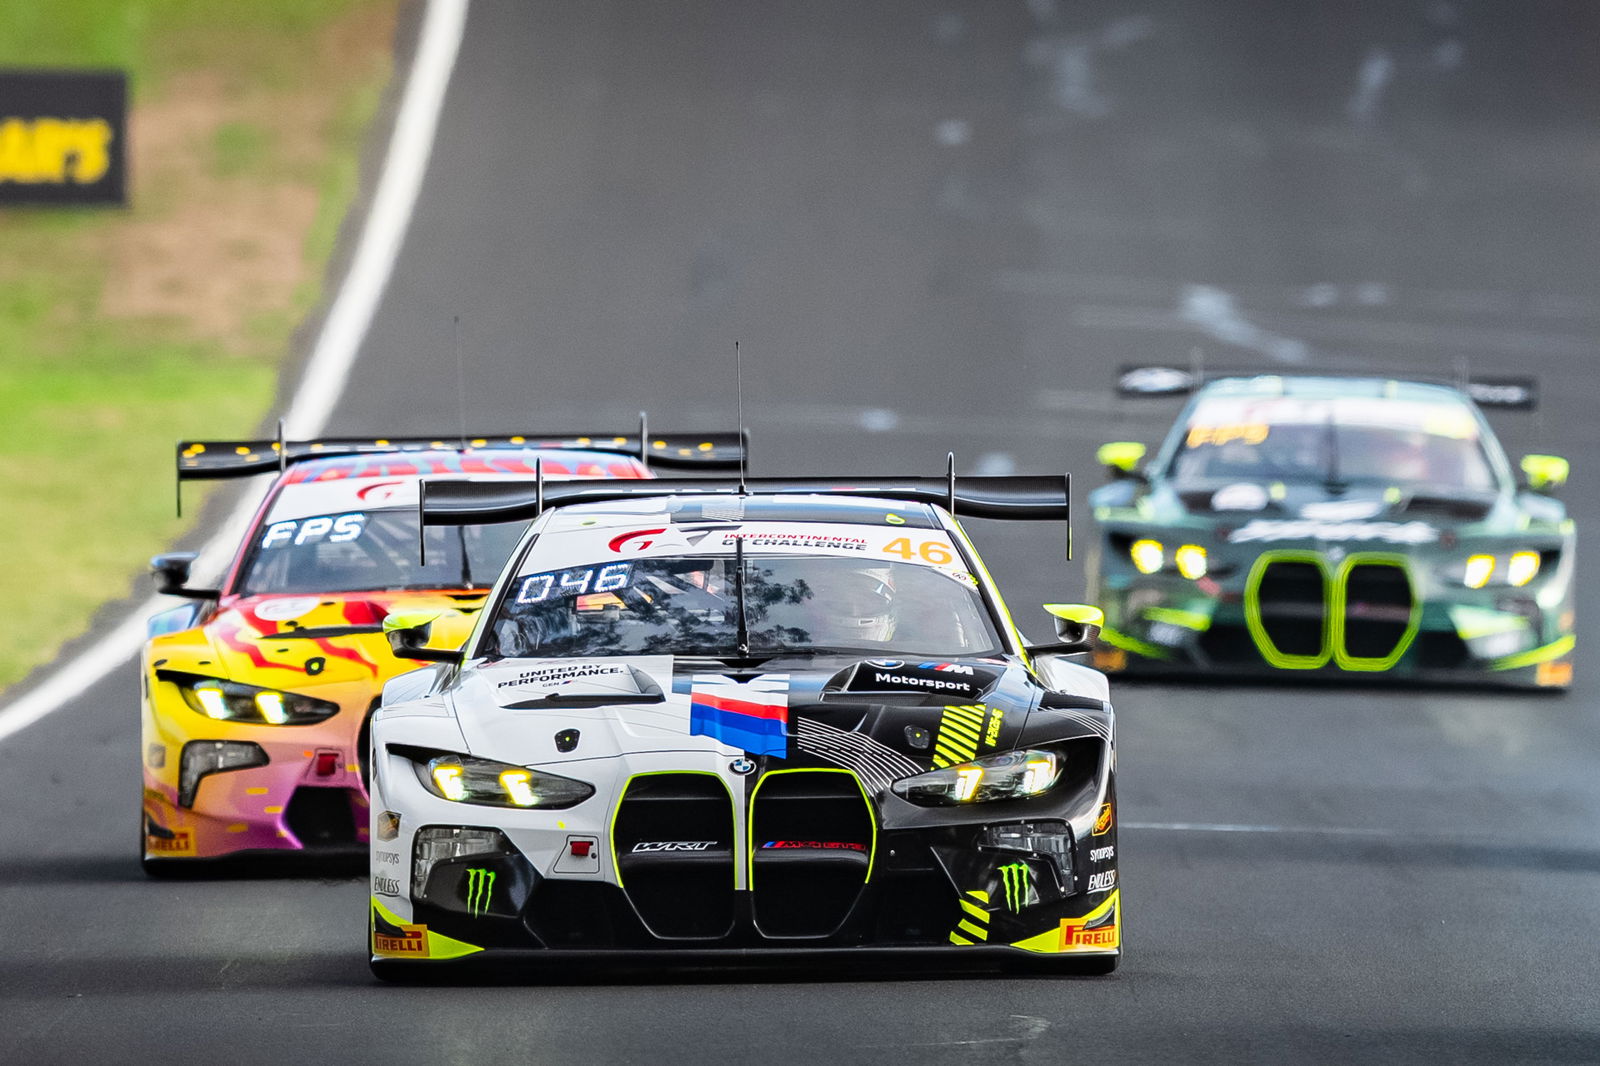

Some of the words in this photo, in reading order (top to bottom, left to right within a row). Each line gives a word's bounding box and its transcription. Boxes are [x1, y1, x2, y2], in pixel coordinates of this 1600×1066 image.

[262, 513, 365, 548] FPS
[724, 533, 868, 543] INTERCONTINENTAL
[751, 538, 868, 551] CHALLENGE
[882, 537, 953, 565] 46
[517, 563, 630, 604] 046
[497, 667, 624, 689] PERFORMANCE.
[520, 666, 578, 678] UNITED
[875, 672, 971, 691] Motorsport
[632, 841, 718, 852] WRT
[374, 876, 400, 895] ENDLESS
[1088, 869, 1116, 891] ENDLESS
